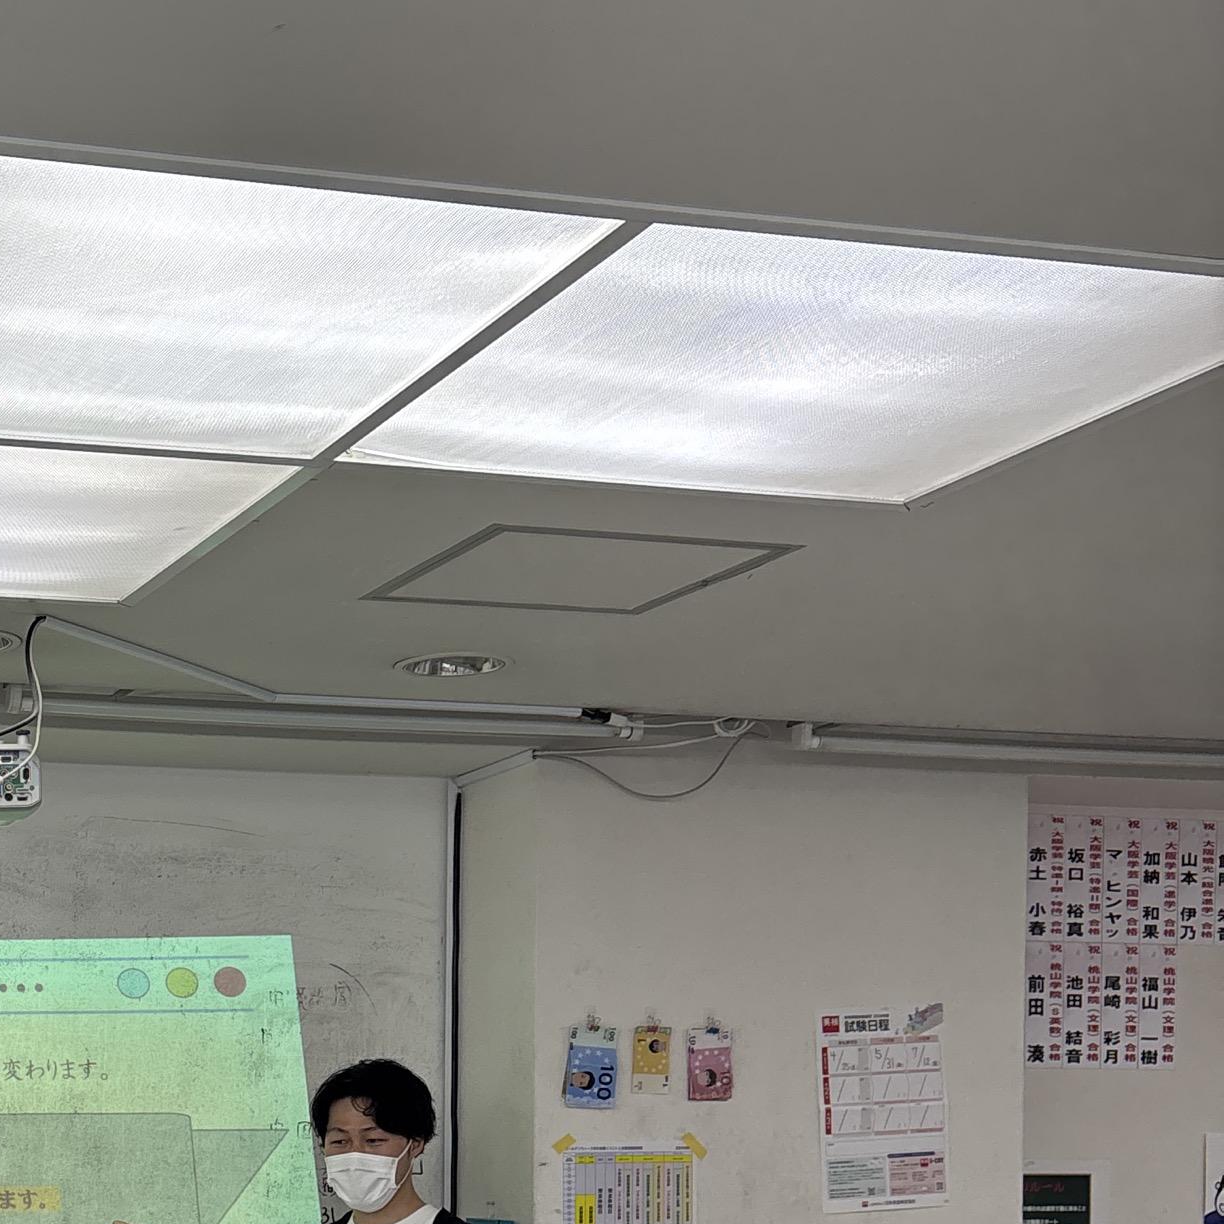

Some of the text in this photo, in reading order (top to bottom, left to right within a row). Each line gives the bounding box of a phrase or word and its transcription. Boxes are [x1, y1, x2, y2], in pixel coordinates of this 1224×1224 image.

[1028, 847, 1047, 936] 赤土 小春
[1066, 848, 1085, 936] 坂口 裕真
[1142, 851, 1160, 939] 加納 和果
[1180, 852, 1198, 940] 山本 伊乃
[844, 1019, 890, 1033] 試験日程
[1028, 975, 1045, 1016] 前田
[1065, 975, 1083, 1064] 池田 結音
[1104, 976, 1121, 1064] 尾崎 彩月
[1141, 977, 1159, 1065] 福山 一樹
[596, 1064, 614, 1100] 100
